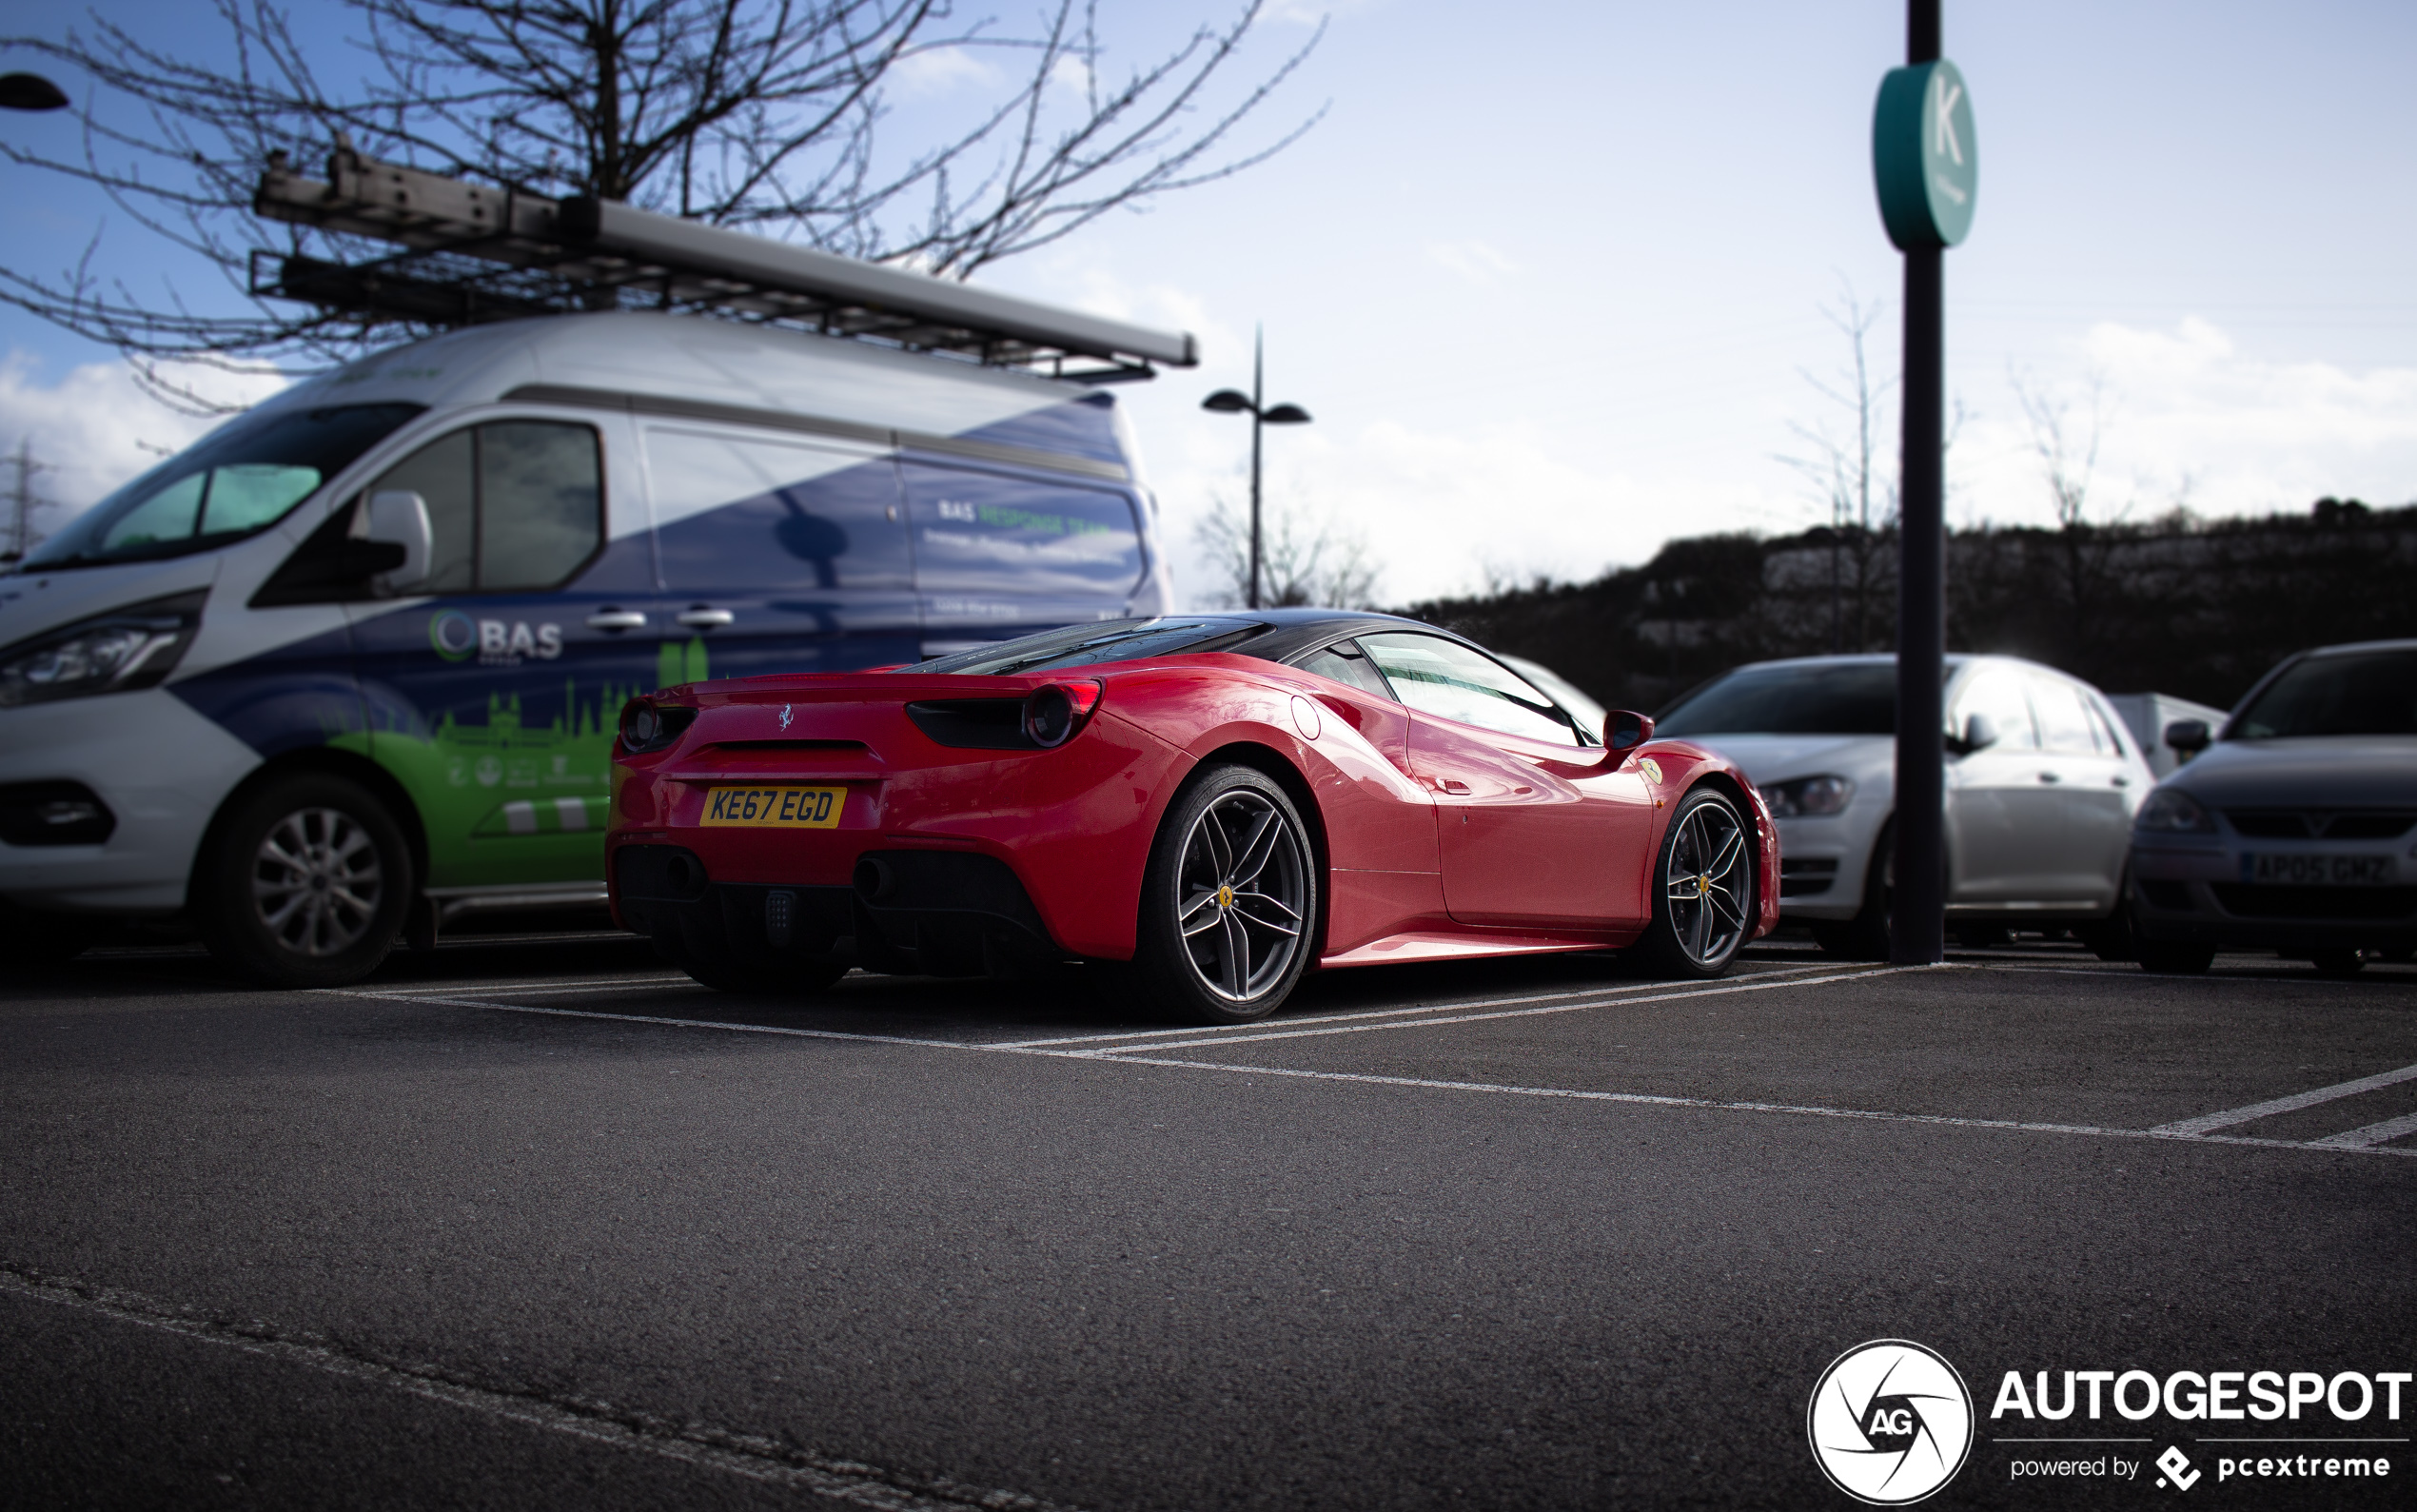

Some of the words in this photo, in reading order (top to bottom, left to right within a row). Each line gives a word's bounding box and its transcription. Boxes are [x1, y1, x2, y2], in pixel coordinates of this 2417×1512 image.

[1936, 74, 1963, 166] K
[479, 620, 562, 659] BAS
[710, 791, 778, 820] KE67
[779, 791, 834, 822] EGD
